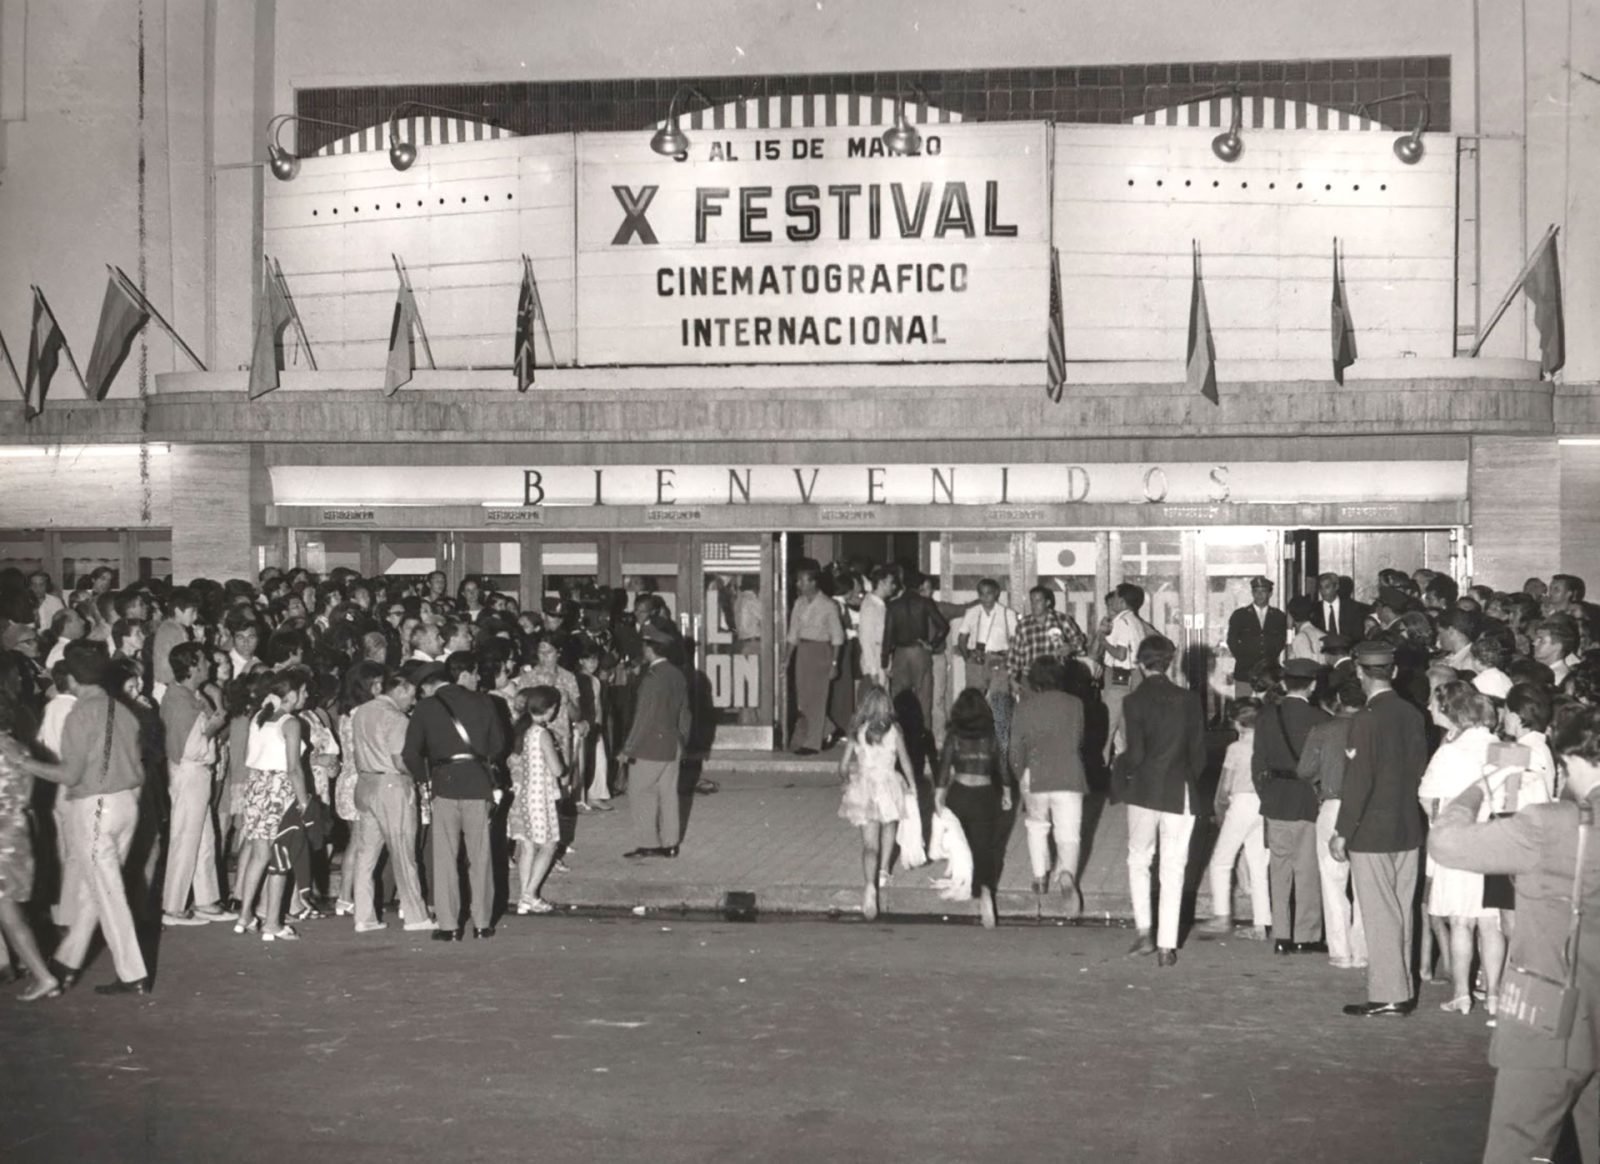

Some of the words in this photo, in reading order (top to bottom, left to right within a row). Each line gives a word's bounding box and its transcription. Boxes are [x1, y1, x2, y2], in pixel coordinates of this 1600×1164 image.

[708, 140, 739, 162] AL
[754, 139, 781, 161] 15
[791, 138, 825, 160] DE
[847, 135, 942, 158] MAO
[610, 184, 660, 246] X
[695, 179, 1019, 243] FESTIVAL
[656, 262, 969, 298] CINEMATOGRAFICO
[681, 315, 947, 347] INTERNACIONAL
[523, 465, 1232, 506] BIENVENIDOS
